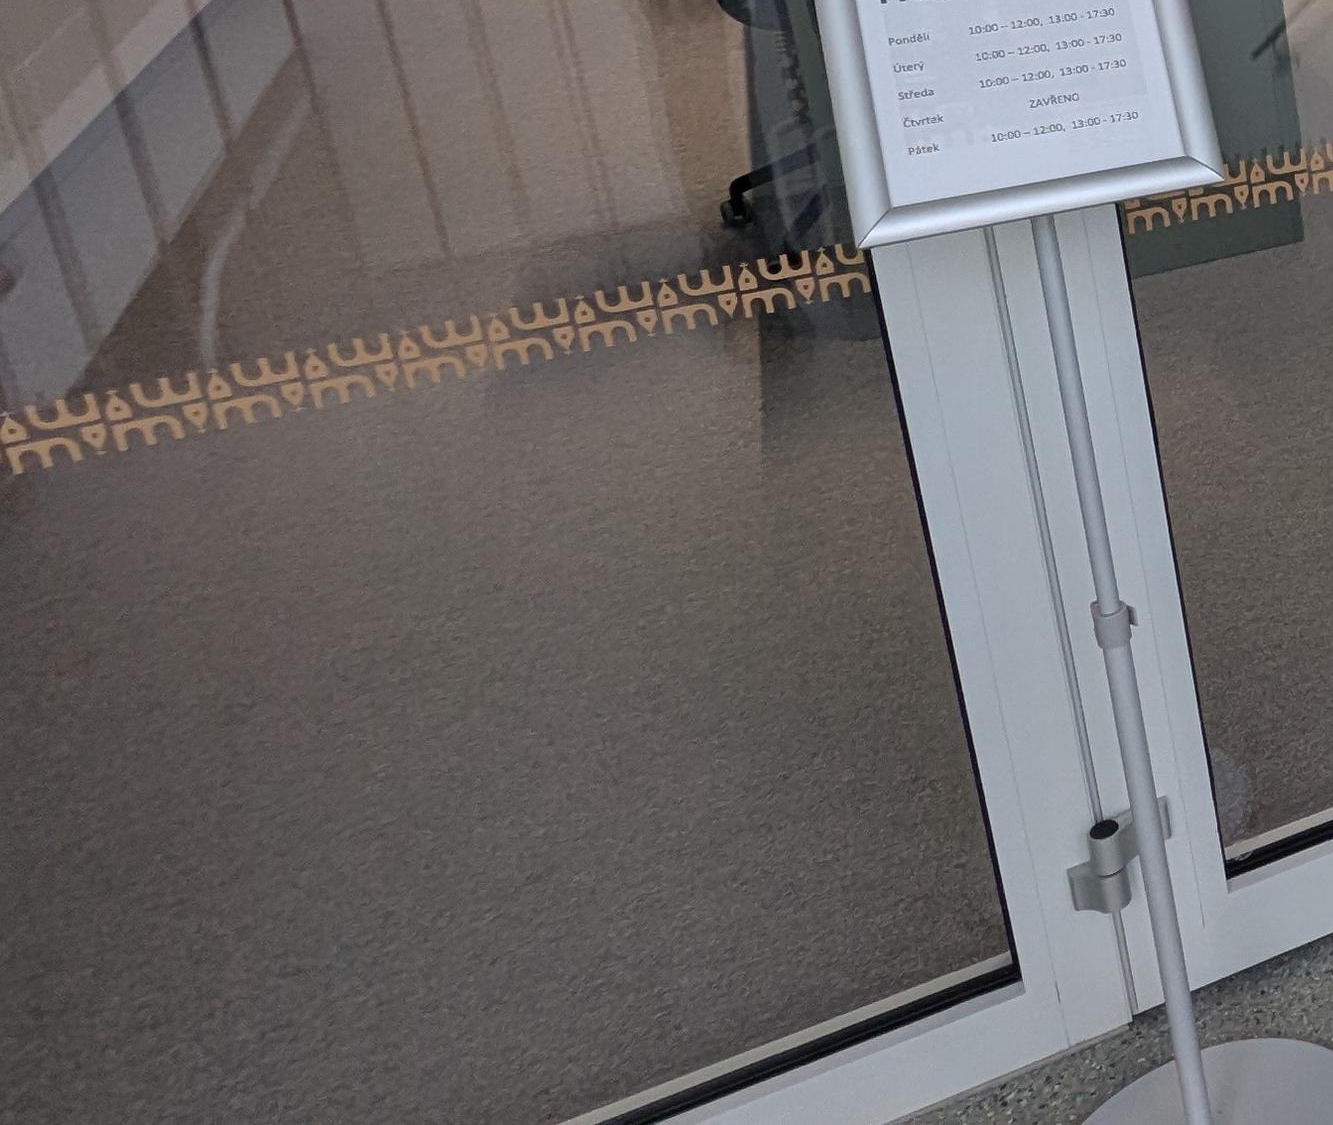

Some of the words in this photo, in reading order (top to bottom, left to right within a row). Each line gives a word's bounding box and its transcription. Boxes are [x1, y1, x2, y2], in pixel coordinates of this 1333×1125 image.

[888, 31, 931, 46] Pondělí
[968, 23, 999, 36] 10:00
[1087, 7, 1115, 20] 17:30
[893, 59, 925, 74] Úterý
[975, 49, 1005, 62] 10:00
[1055, 37, 1085, 51] 13:00
[1093, 32, 1122, 46] 17:30
[898, 87, 935, 101] Středa
[979, 76, 1009, 89] 10:00
[1060, 64, 1089, 77] 13:00
[1098, 59, 1127, 72] 17:30
[1029, 92, 1080, 109] ZAVŘENO
[908, 144, 940, 157] Pátek
[991, 129, 1021, 143] 10:00
[1072, 116, 1101, 130] 13:00
[1110, 110, 1139, 124] 17:30
